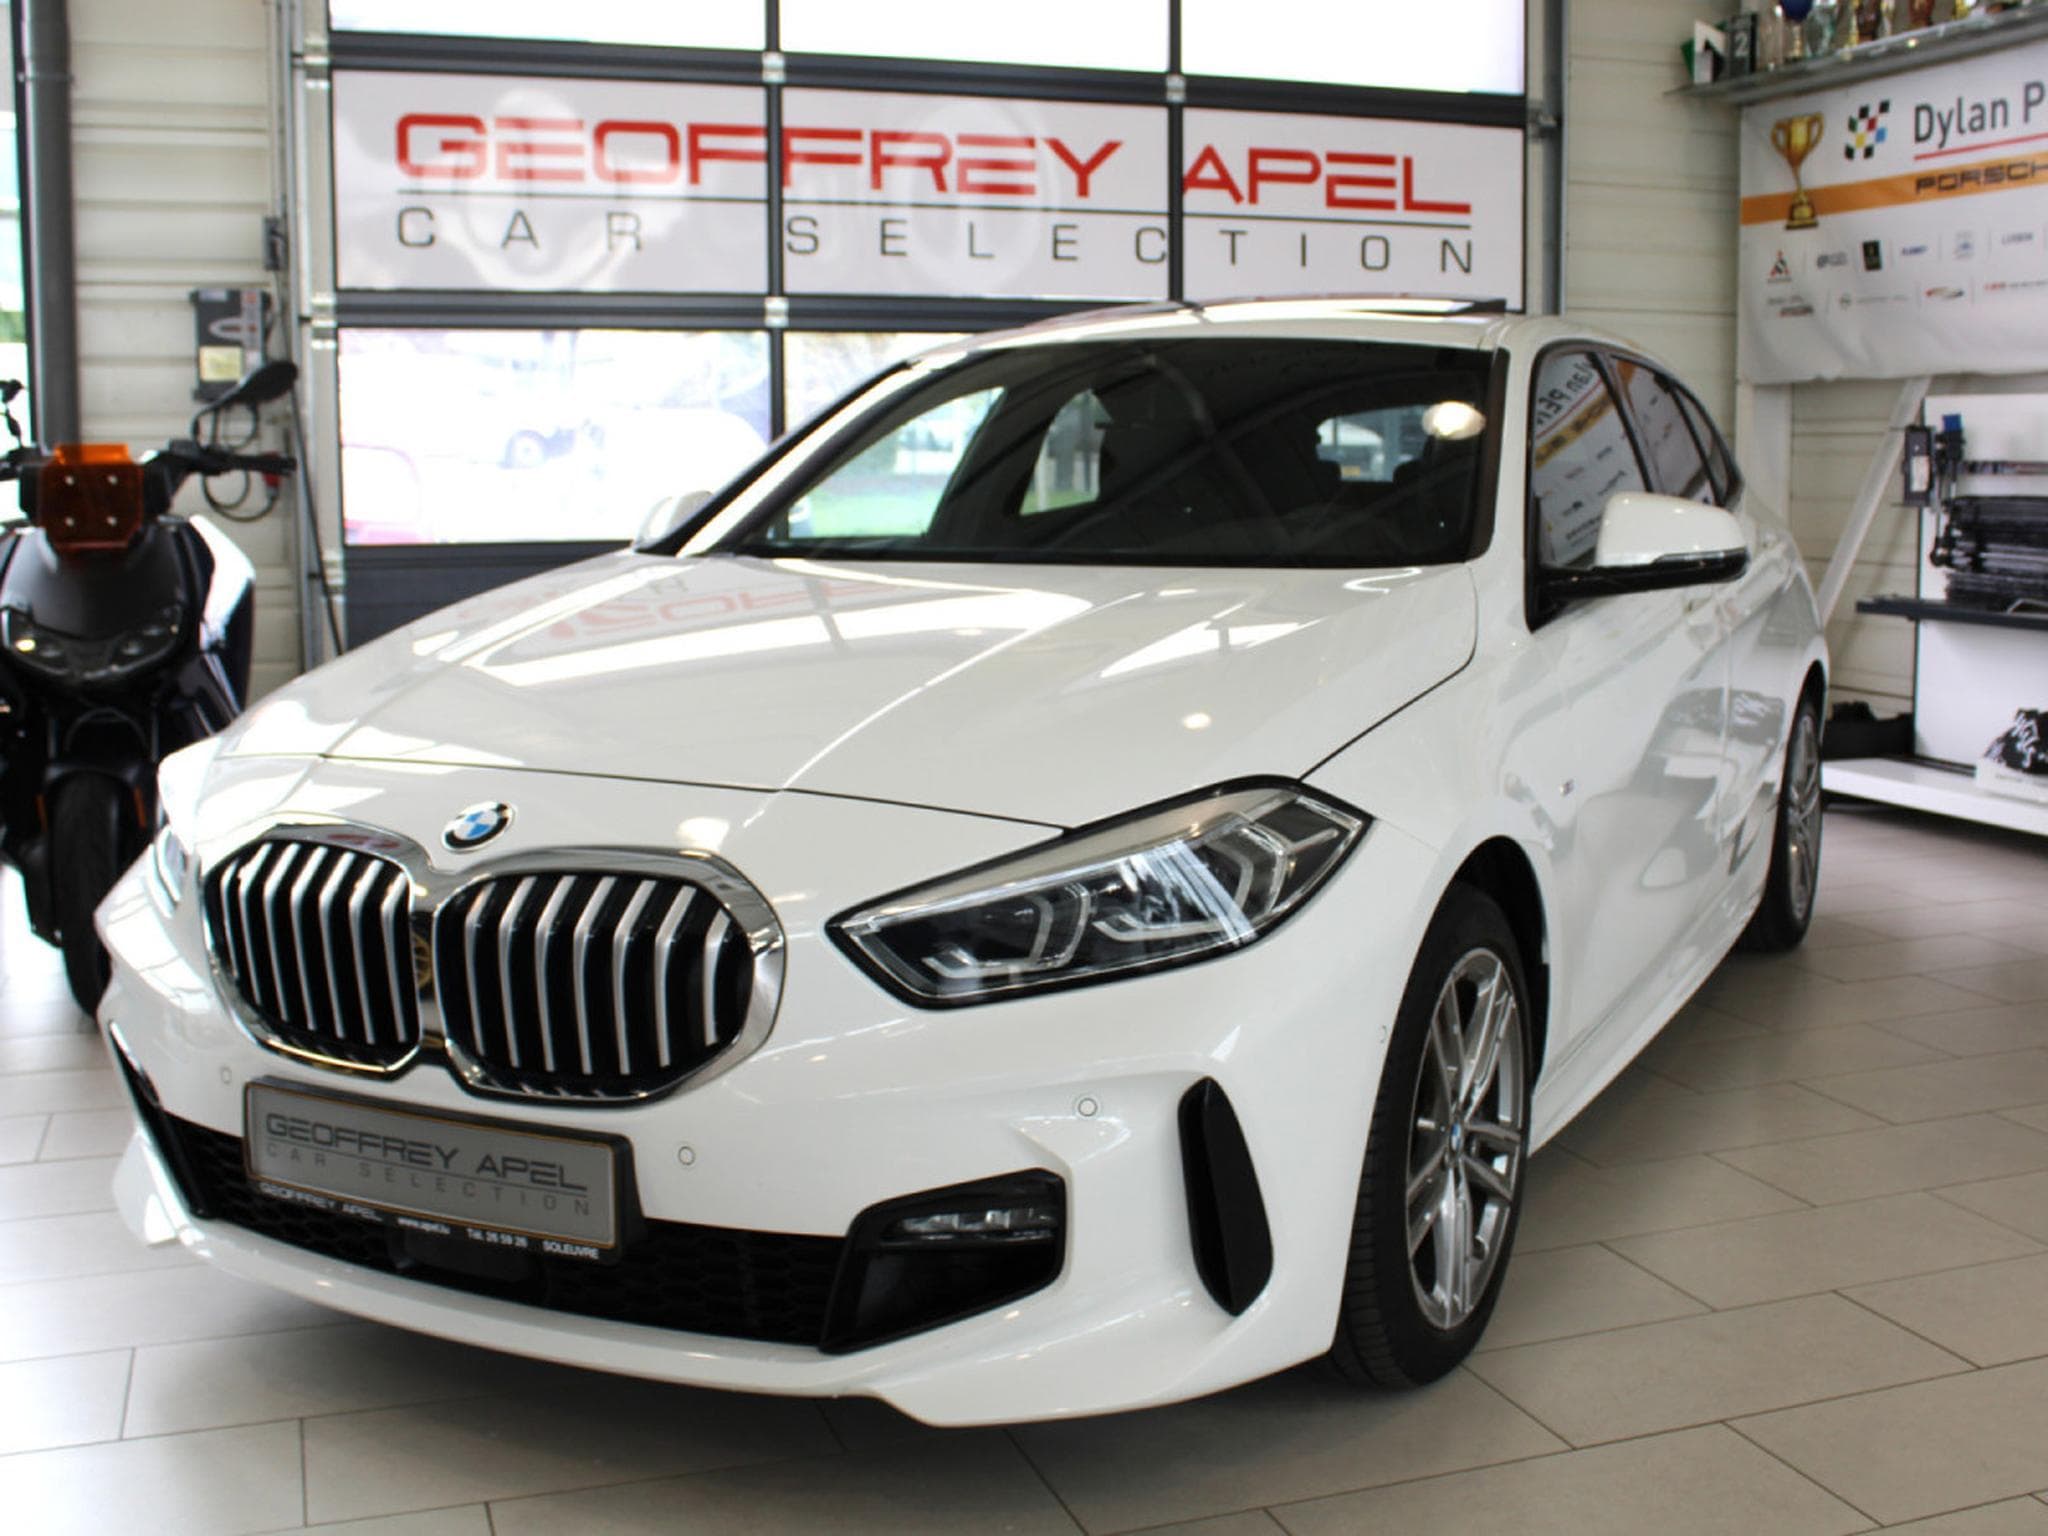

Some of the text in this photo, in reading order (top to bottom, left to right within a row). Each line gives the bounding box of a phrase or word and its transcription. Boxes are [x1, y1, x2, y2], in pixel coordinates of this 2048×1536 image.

[1914, 97, 2008, 149] Dylan
[395, 113, 1472, 214] GEOFFREY APEL
[396, 206, 1472, 274] CAR SELECTION
[266, 1112, 588, 1191] GEOFFREY APEL
[266, 1142, 590, 1217] CAR SELECTION
[259, 1182, 337, 1210] GEOFFREY
